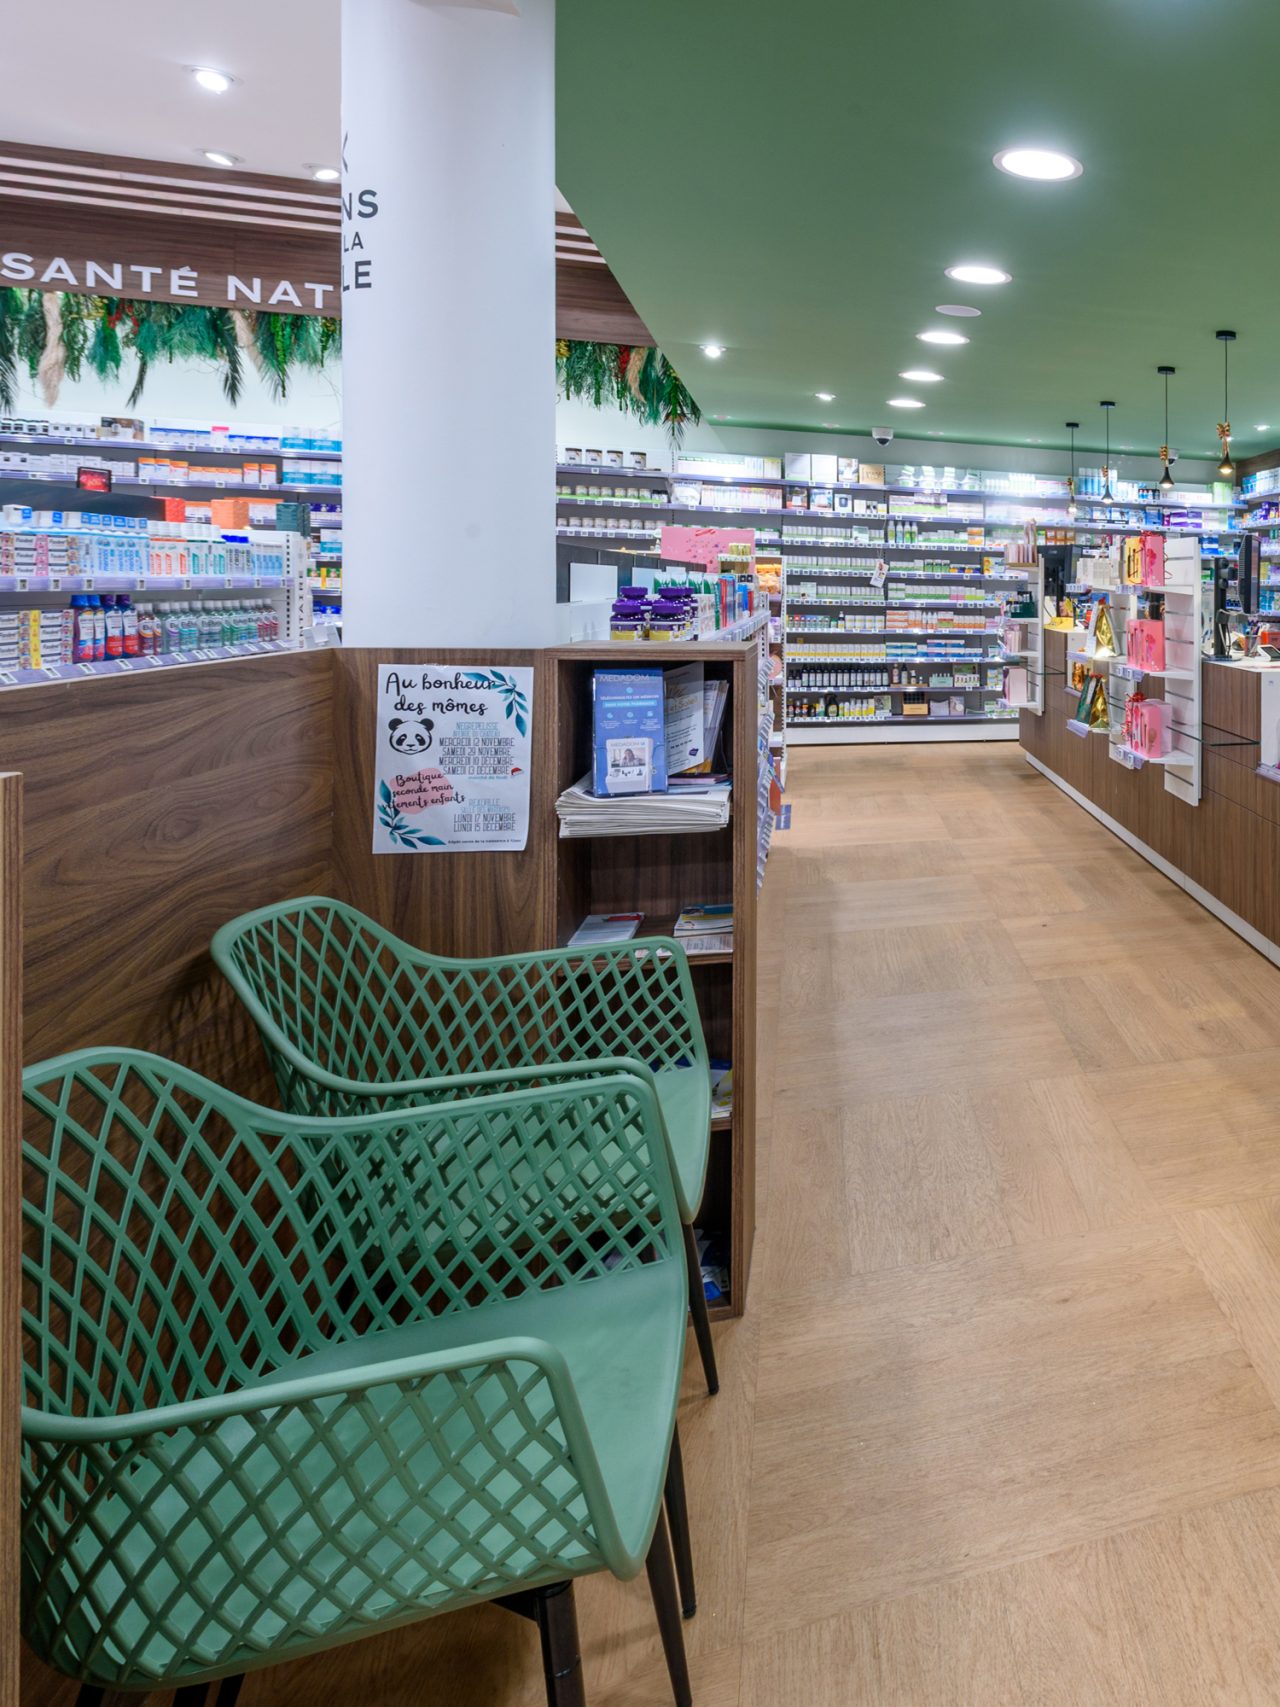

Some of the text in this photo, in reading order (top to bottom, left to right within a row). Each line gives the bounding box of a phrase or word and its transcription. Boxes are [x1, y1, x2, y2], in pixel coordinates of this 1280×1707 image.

[0, 252, 199, 298] SANTÉ
[386, 672, 496, 696] Au bonheur
[394, 694, 488, 716] des mômes
[395, 772, 443, 787] Boutique
[393, 784, 454, 798] seconde main
[431, 791, 465, 805] enfants
